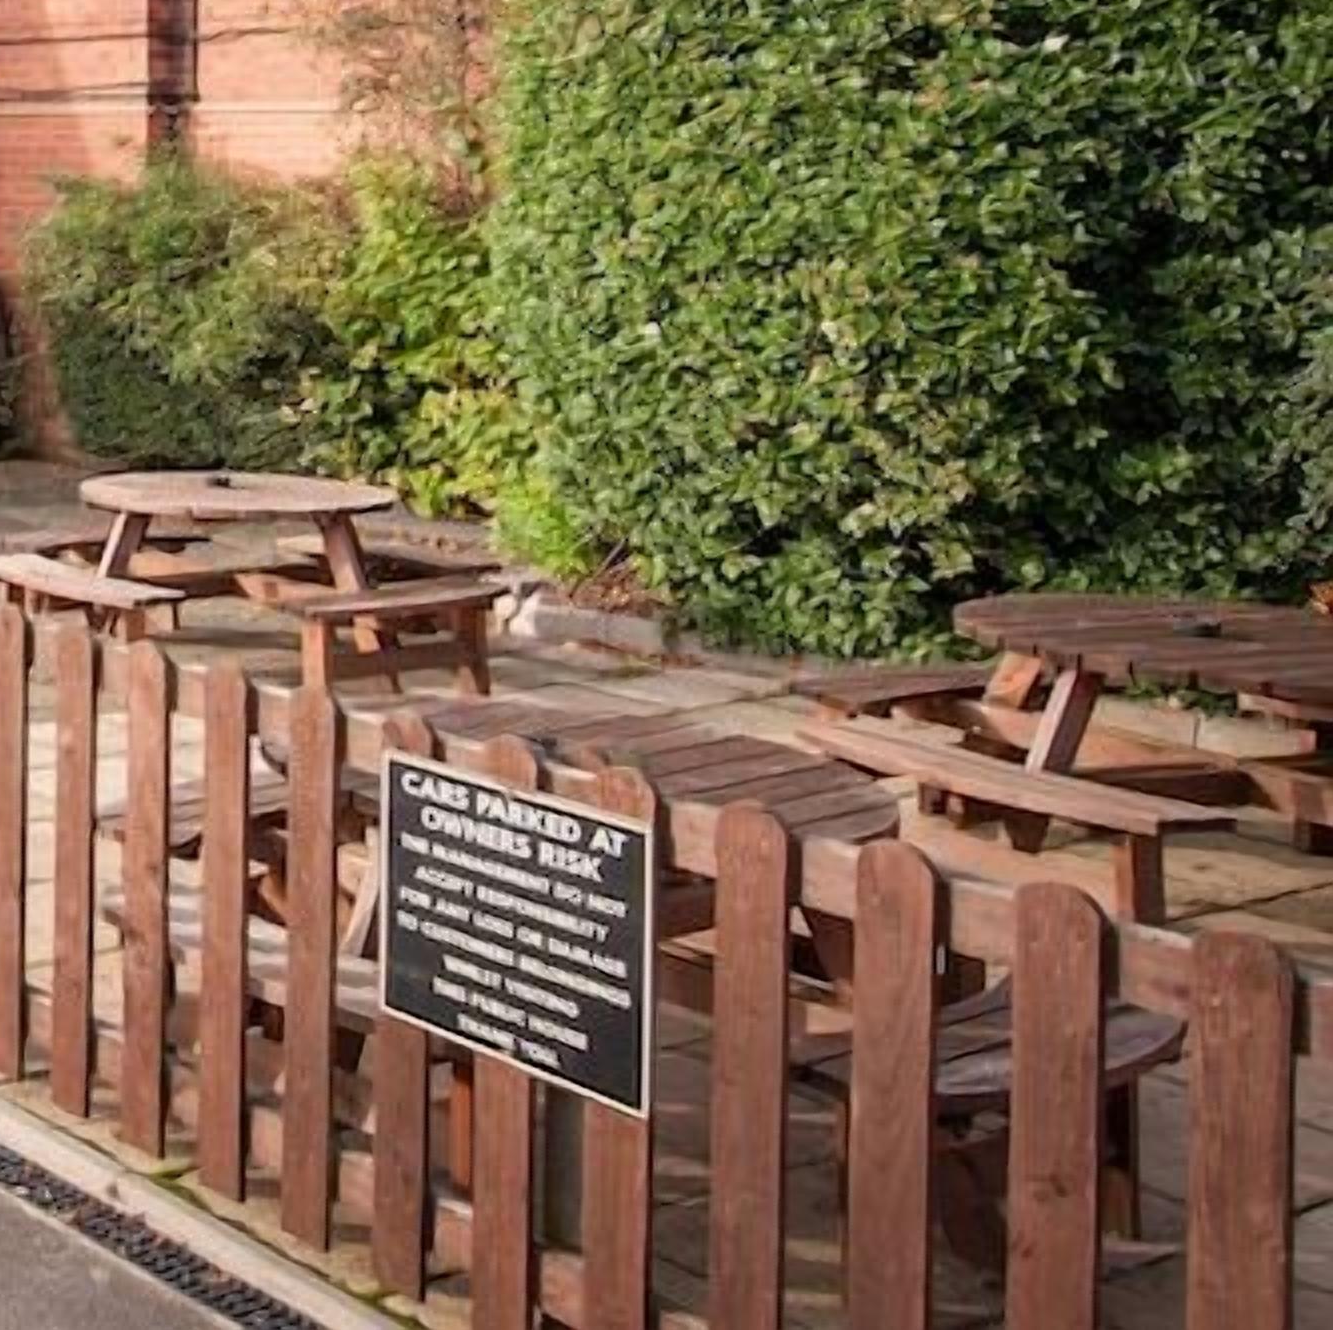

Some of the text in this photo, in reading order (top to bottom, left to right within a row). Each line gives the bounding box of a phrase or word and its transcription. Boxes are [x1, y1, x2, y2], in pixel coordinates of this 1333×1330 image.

[401, 771, 627, 856] CARS PARKED AT
[421, 806, 601, 881] OWNERS RISK
